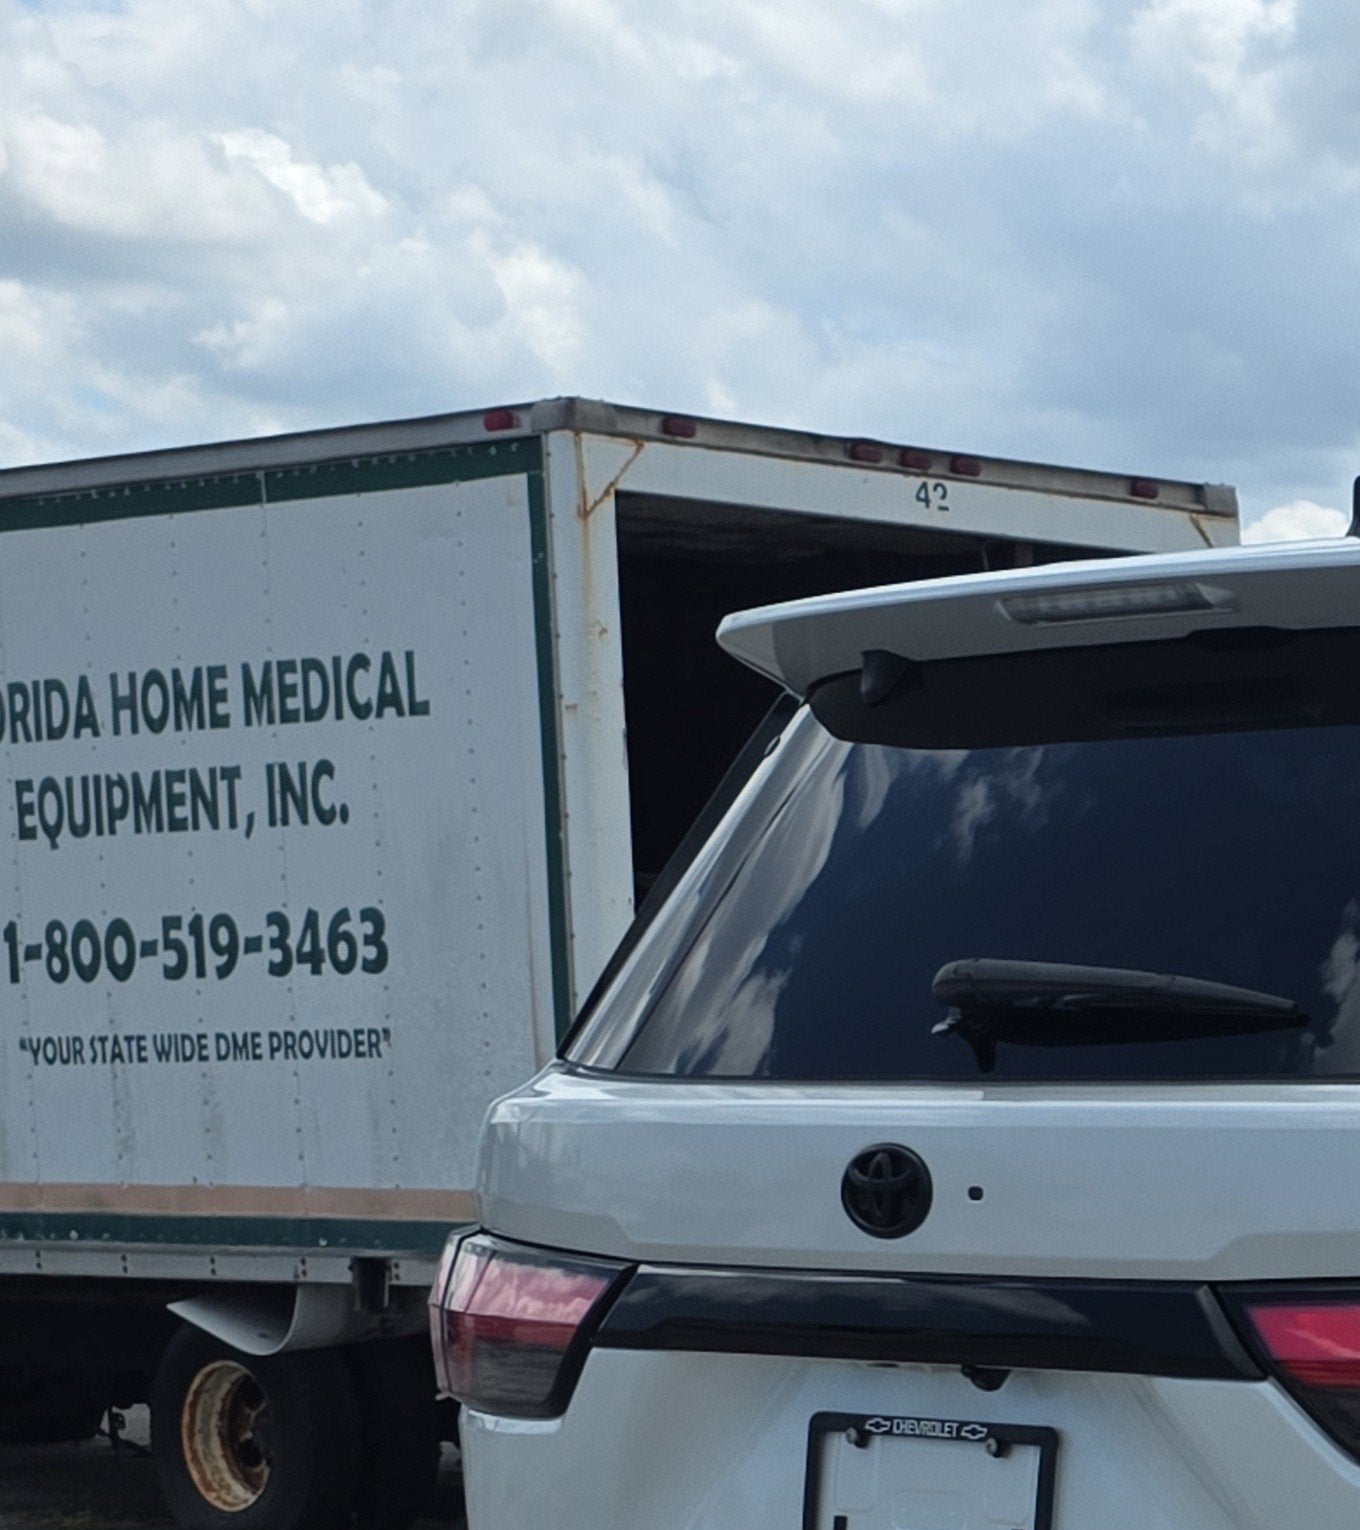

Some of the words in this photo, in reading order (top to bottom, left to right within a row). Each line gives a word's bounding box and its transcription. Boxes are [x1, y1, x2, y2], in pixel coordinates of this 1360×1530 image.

[915, 481, 950, 512] 42
[0, 674, 101, 744] RIDA
[109, 664, 231, 736] HOME
[241, 650, 430, 727] MEDICAL
[15, 765, 255, 850] EQUIPMENT,
[265, 758, 350, 828] INC.
[3, 907, 389, 984] 1-800-519-3463
[89, 1034, 148, 1065] STATE
[152, 1032, 210, 1063] WIDE
[214, 1031, 264, 1062] DME
[892, 1418, 960, 1438] CHEVROLET
